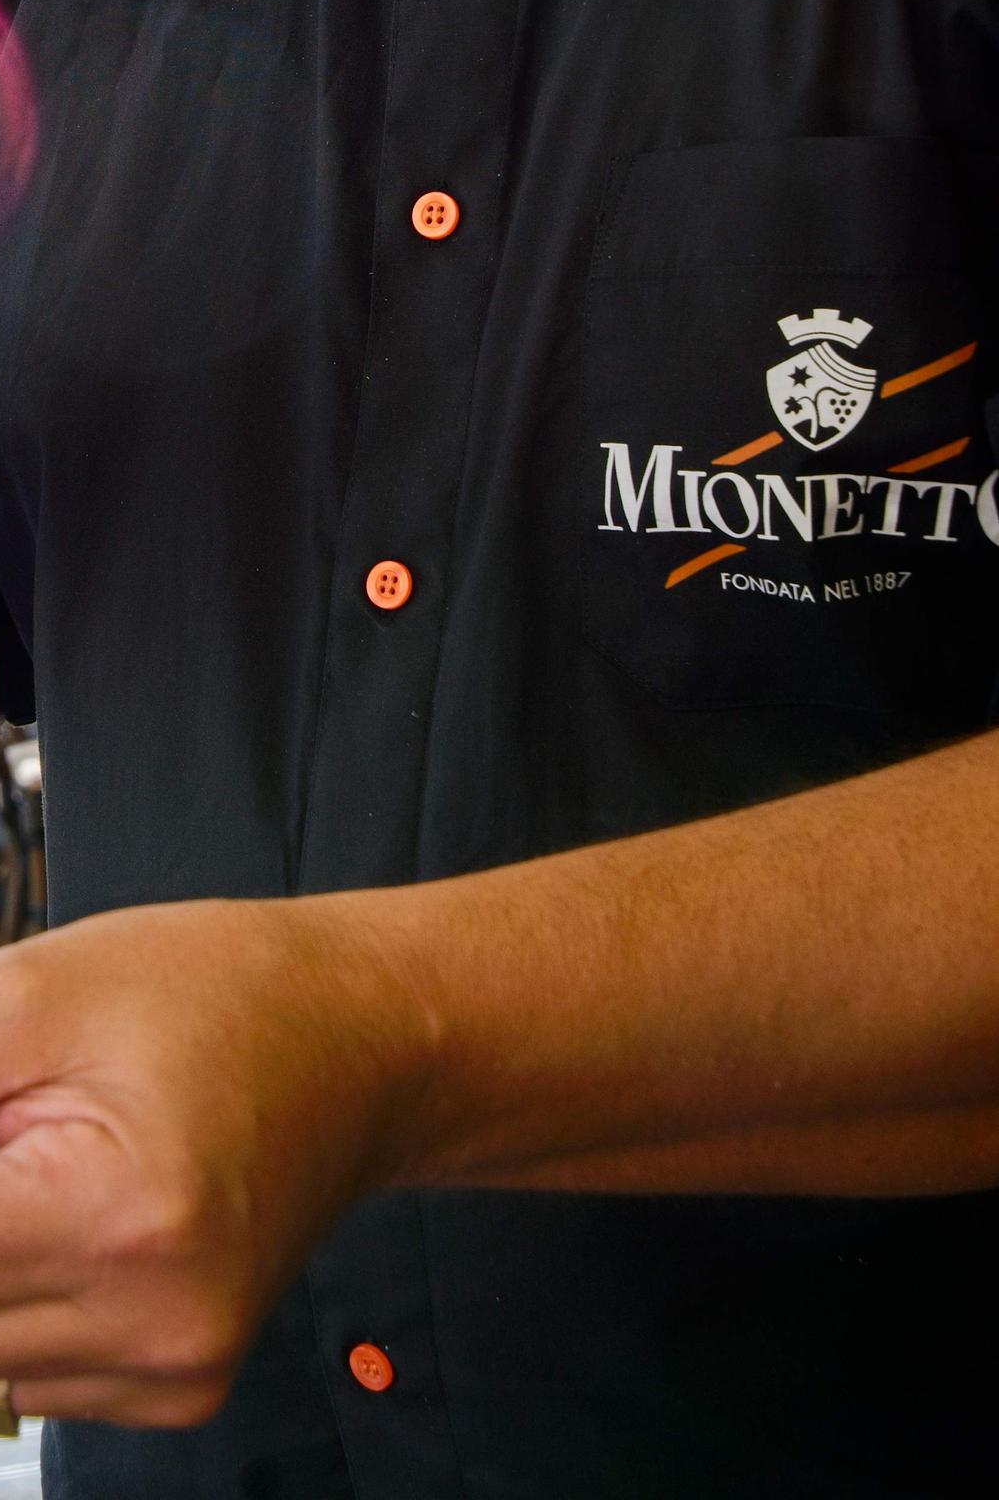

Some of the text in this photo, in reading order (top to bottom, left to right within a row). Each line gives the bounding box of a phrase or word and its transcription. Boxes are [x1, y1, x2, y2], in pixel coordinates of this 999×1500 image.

[719, 571, 912, 603] FONDATA NEL 1887
